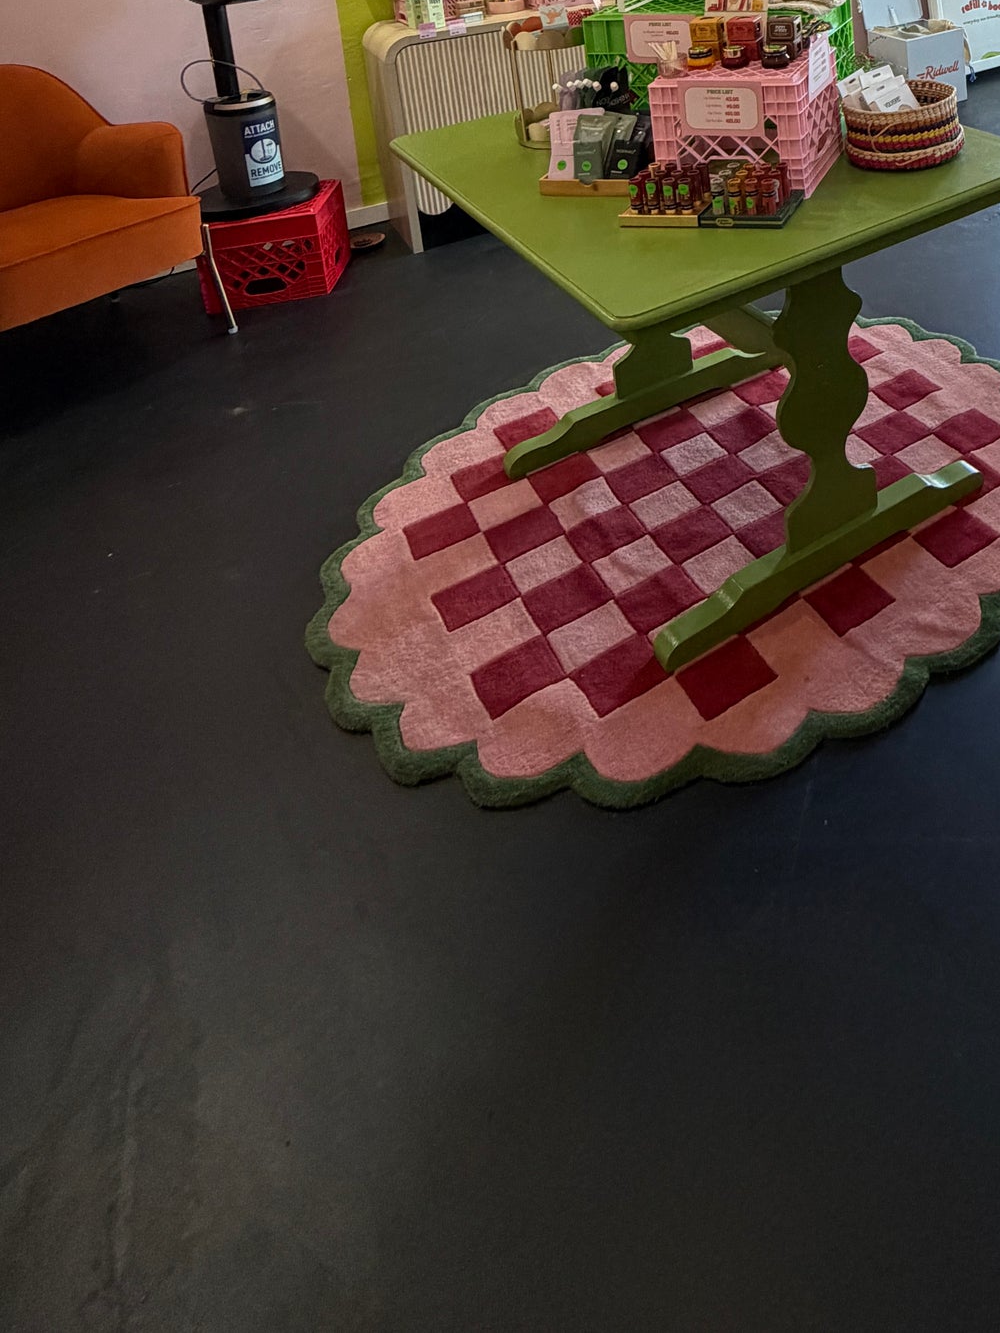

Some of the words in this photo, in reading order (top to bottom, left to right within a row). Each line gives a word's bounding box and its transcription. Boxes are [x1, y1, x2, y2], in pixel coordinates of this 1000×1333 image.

[962, 0, 980, 14] refill
[922, 61, 959, 79] Ridwell
[245, 120, 275, 136] ATTACH
[251, 161, 281, 178] REMOVE
